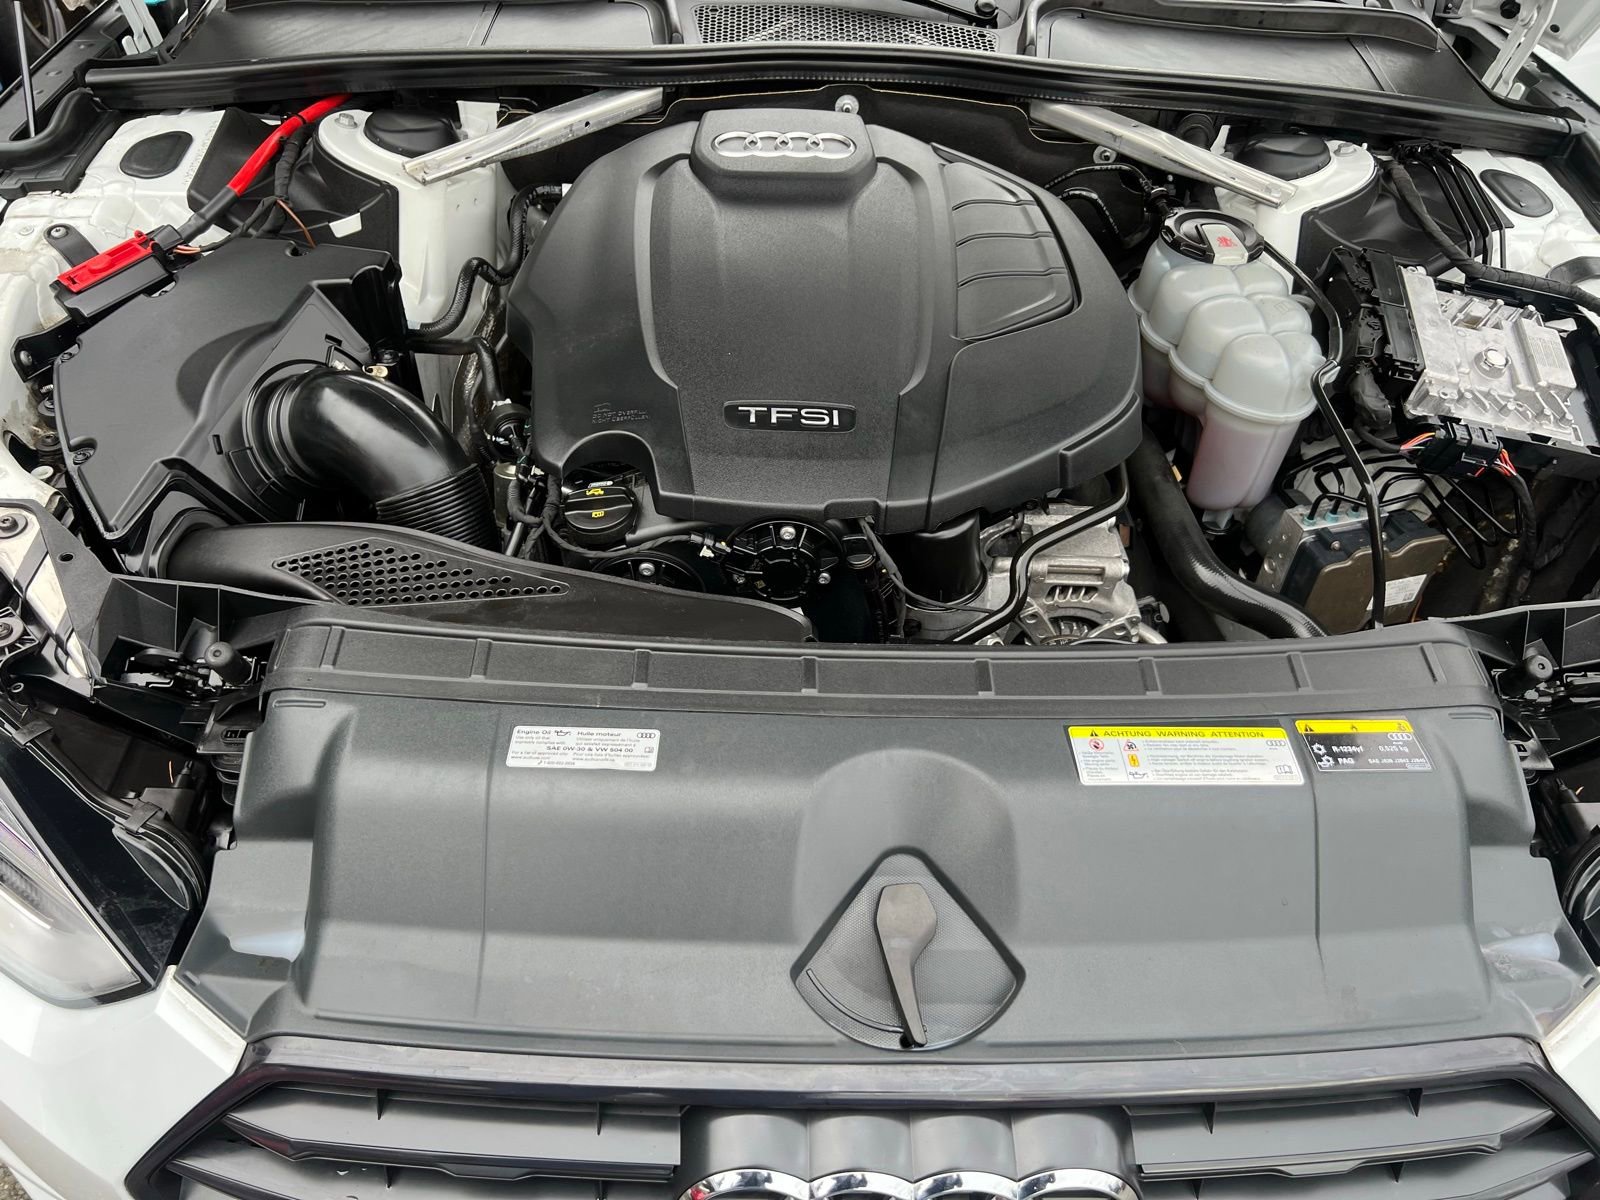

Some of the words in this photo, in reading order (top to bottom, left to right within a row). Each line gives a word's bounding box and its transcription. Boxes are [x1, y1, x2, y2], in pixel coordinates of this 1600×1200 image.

[738, 406, 840, 426] TFSI
[1155, 730, 1206, 738] WARNING
[1337, 757, 1355, 765] PAG
